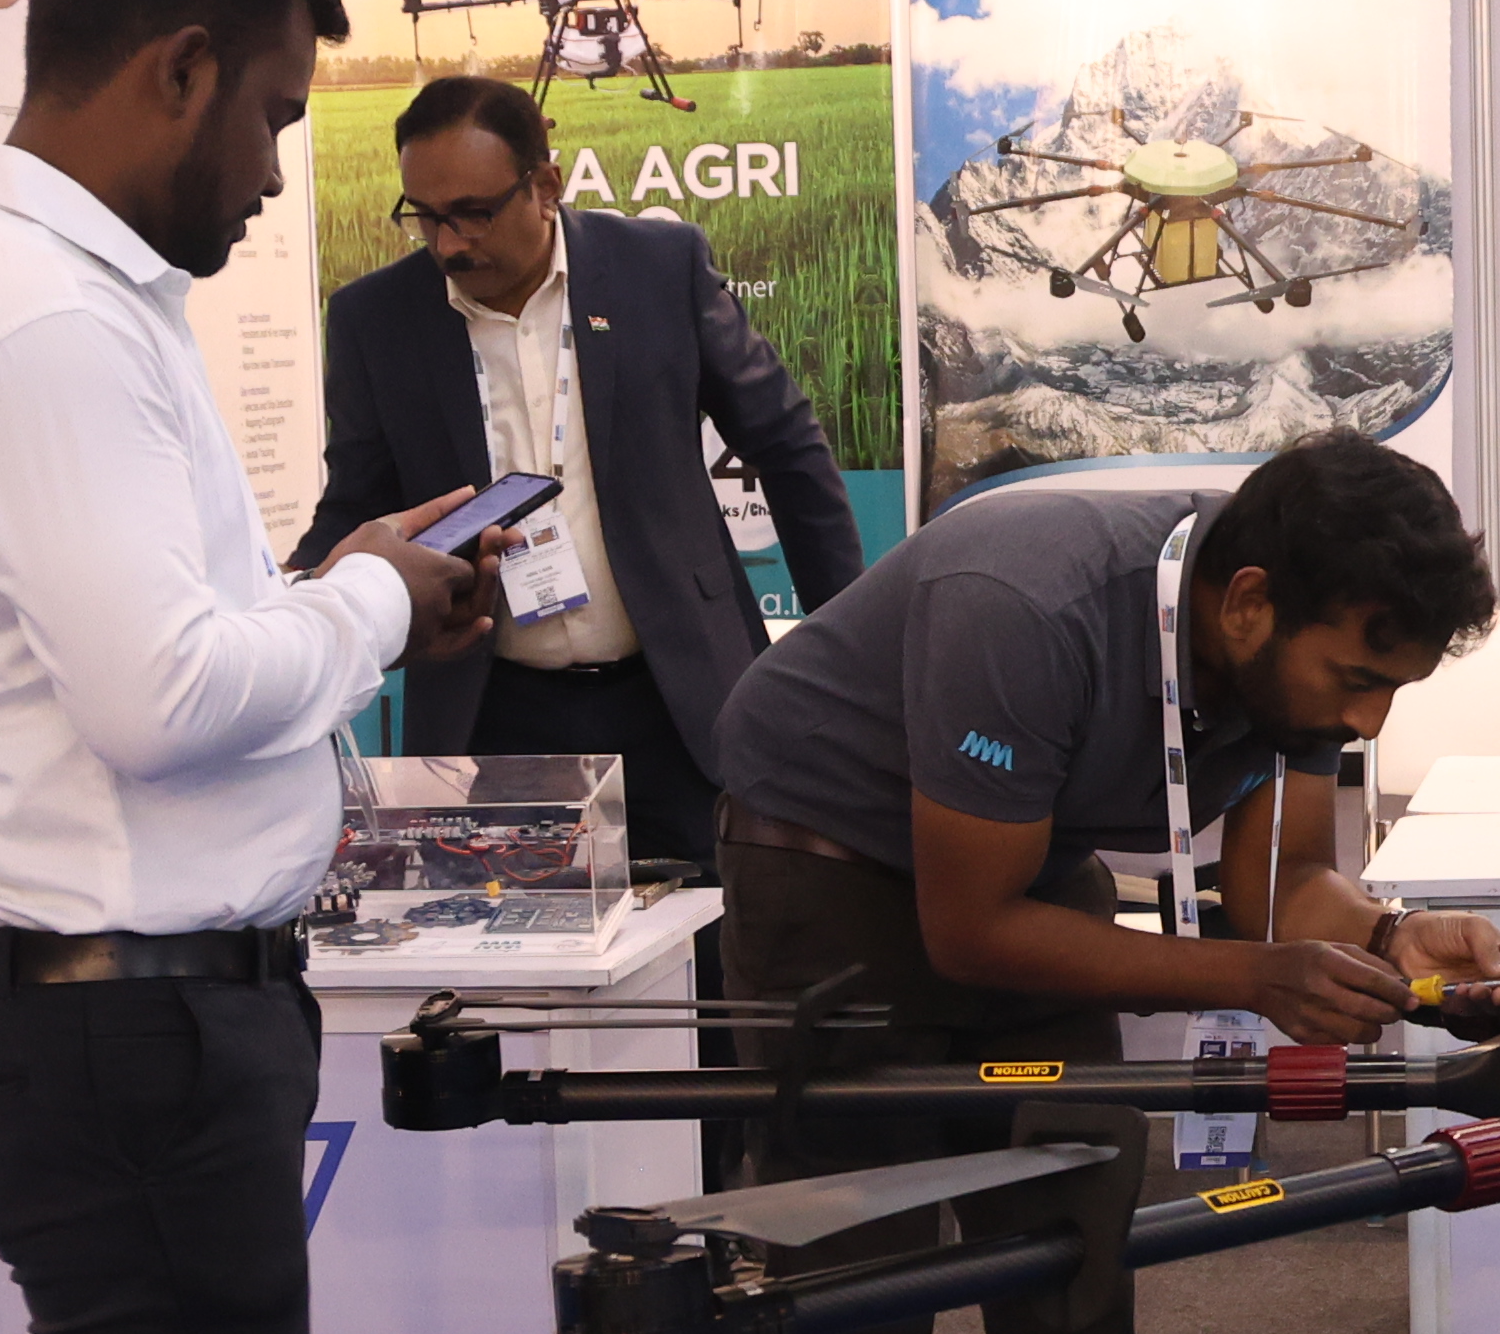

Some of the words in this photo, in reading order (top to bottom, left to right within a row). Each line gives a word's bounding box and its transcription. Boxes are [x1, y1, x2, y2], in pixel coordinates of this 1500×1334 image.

[630, 140, 799, 202] AGRI
[726, 279, 777, 299] tner
[992, 1065, 1051, 1077] CAUTION
[1216, 1185, 1272, 1204] CAUTION
